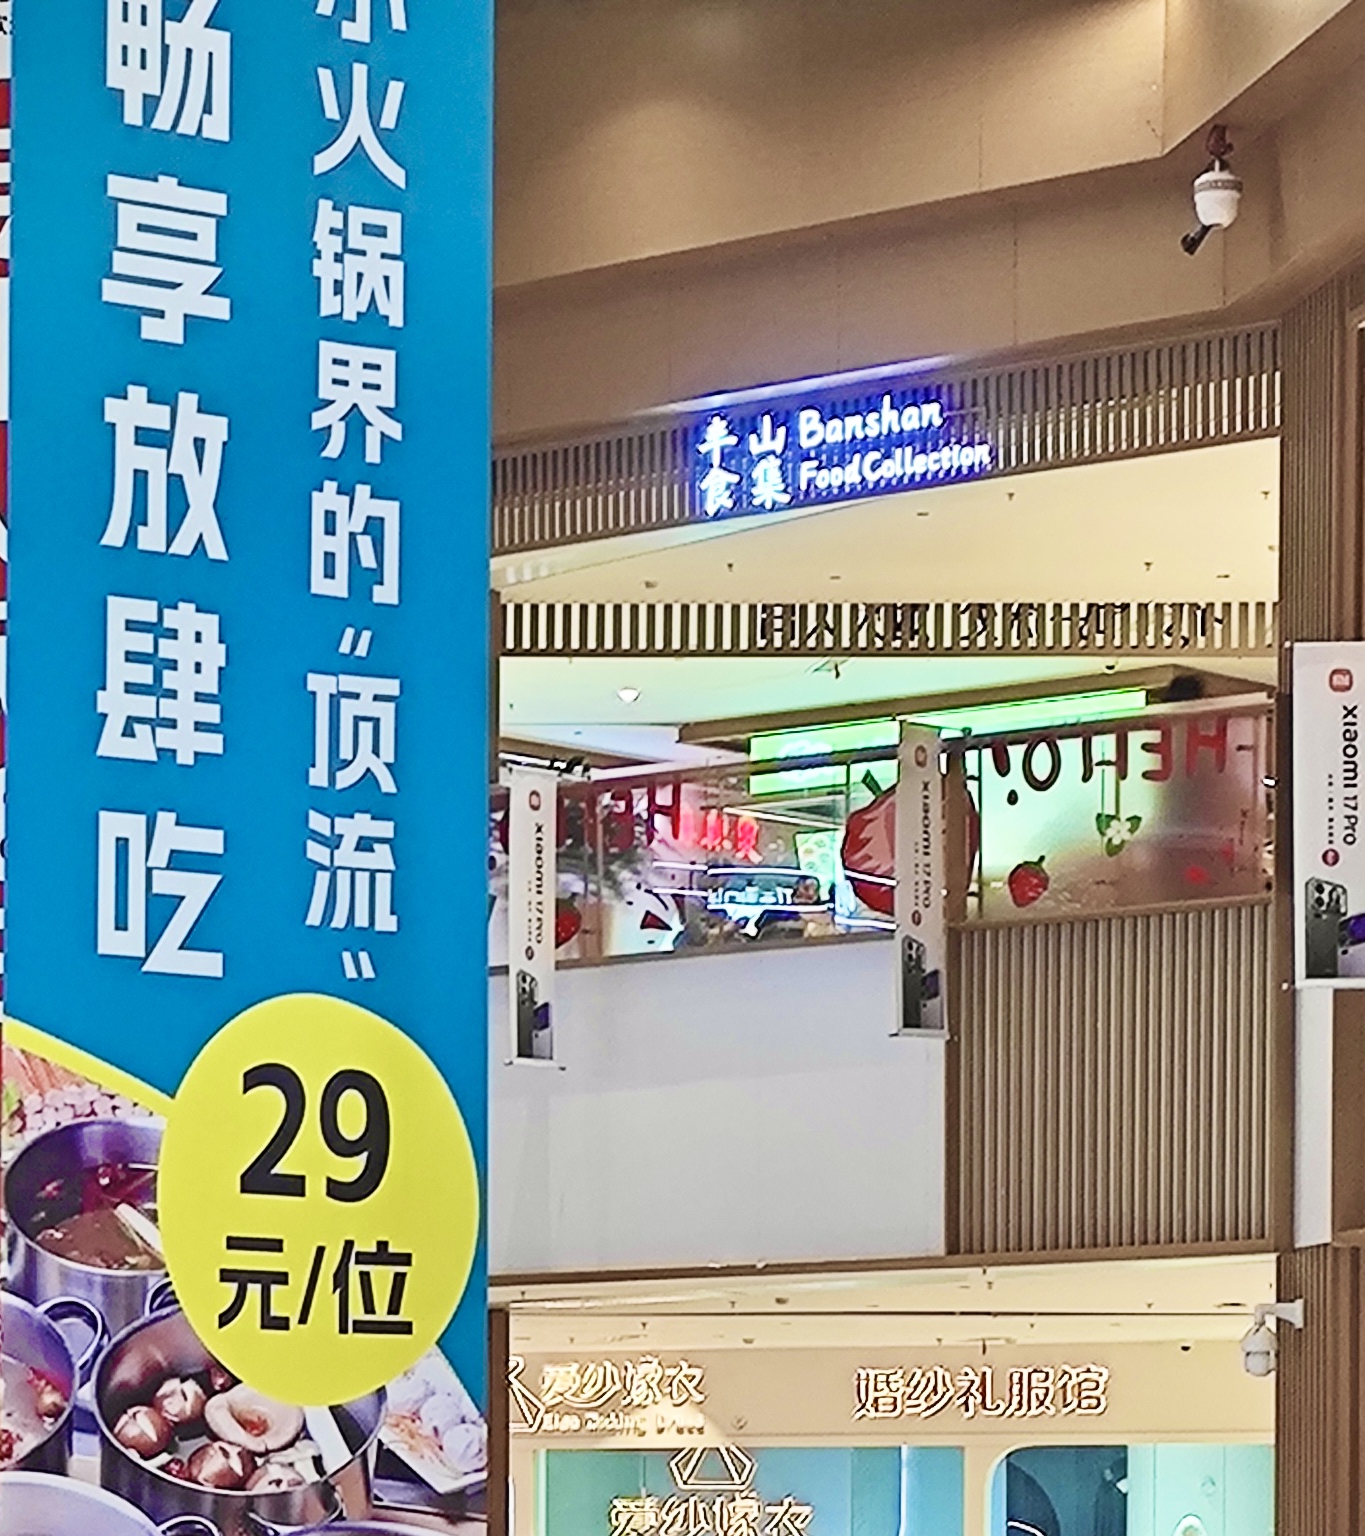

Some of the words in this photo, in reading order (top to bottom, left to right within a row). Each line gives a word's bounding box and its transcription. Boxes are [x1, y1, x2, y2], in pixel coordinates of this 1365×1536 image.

[798, 393, 944, 450] Banshan
[97, 0, 231, 978] 畅享放肆吃
[239, 1063, 391, 1203] 29
[217, 1235, 414, 1336] 元/位
[851, 1364, 1110, 1420] 婚纱礼服馆
